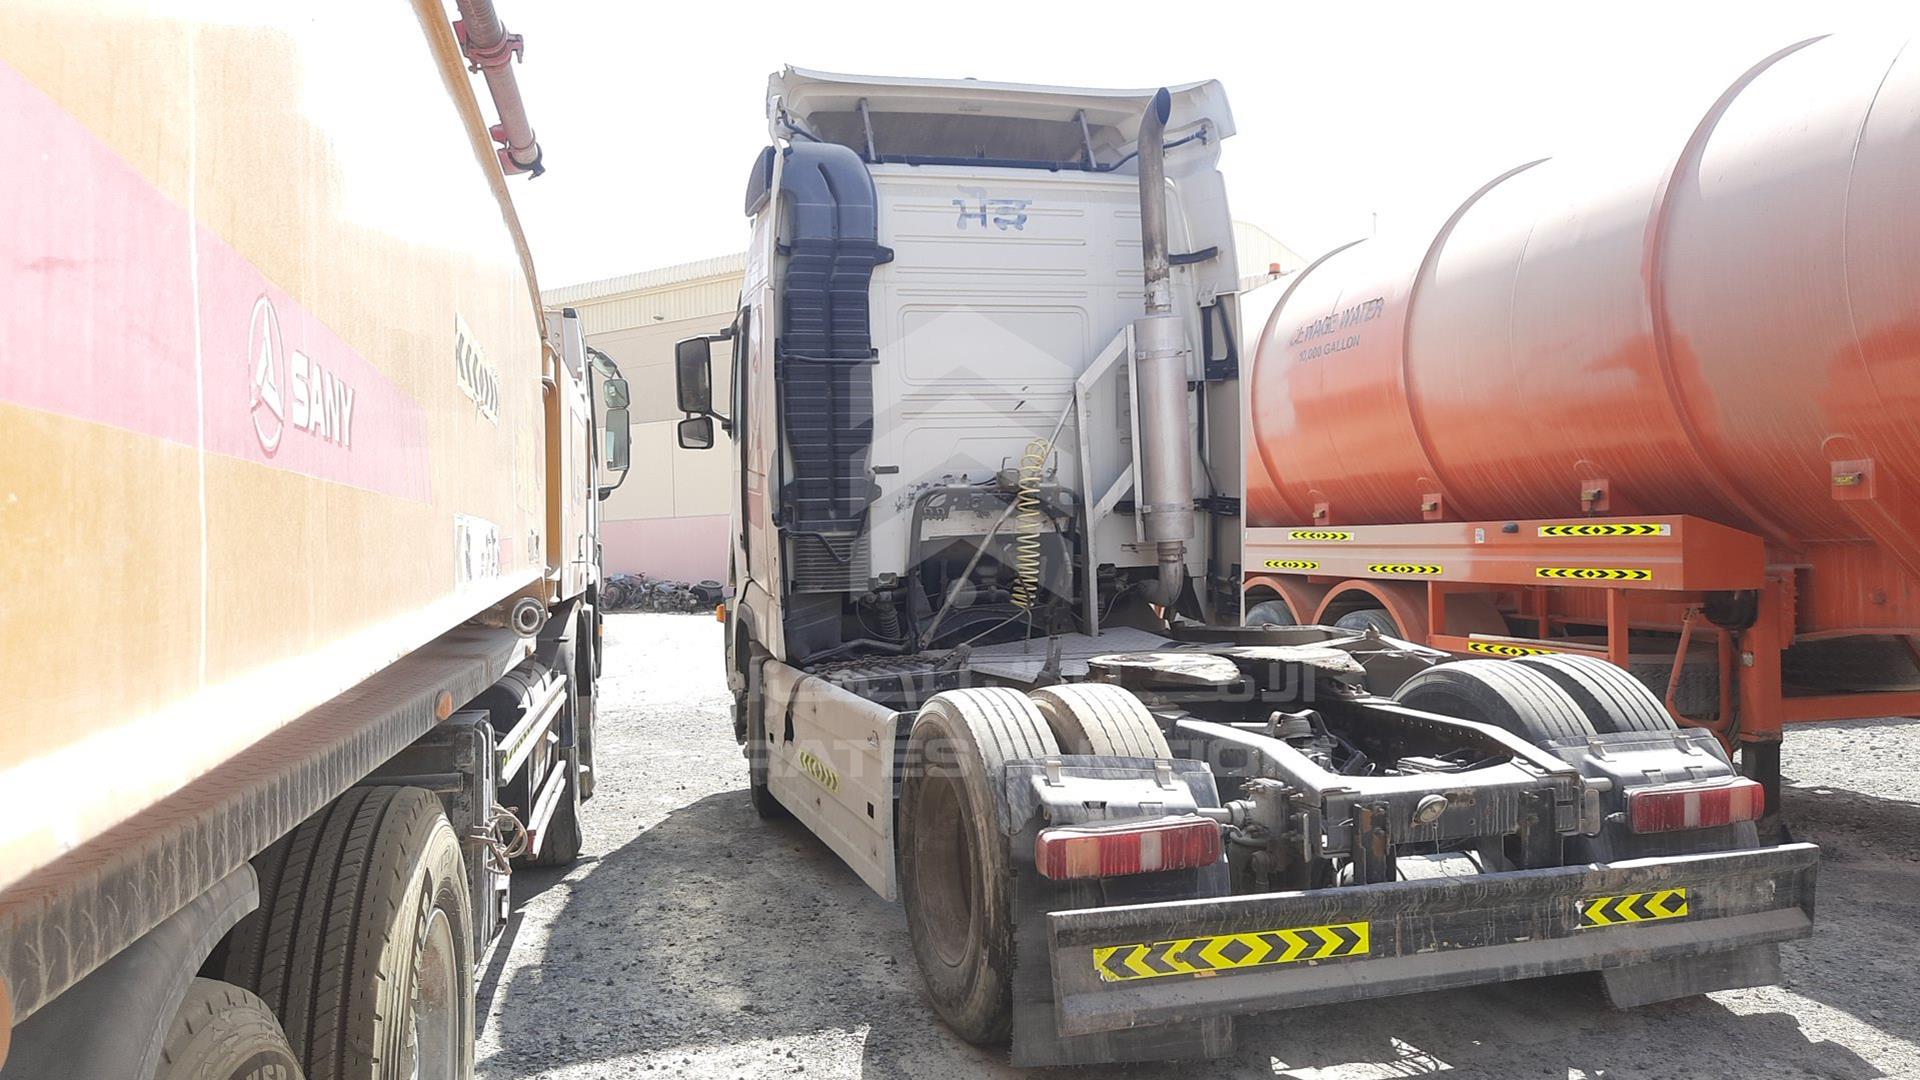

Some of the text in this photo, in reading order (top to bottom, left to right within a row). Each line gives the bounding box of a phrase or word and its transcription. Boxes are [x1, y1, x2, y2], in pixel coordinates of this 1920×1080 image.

[1340, 296, 1385, 328] WATER
[1323, 334, 1360, 355] GALLON
[292, 350, 355, 450] SANY
